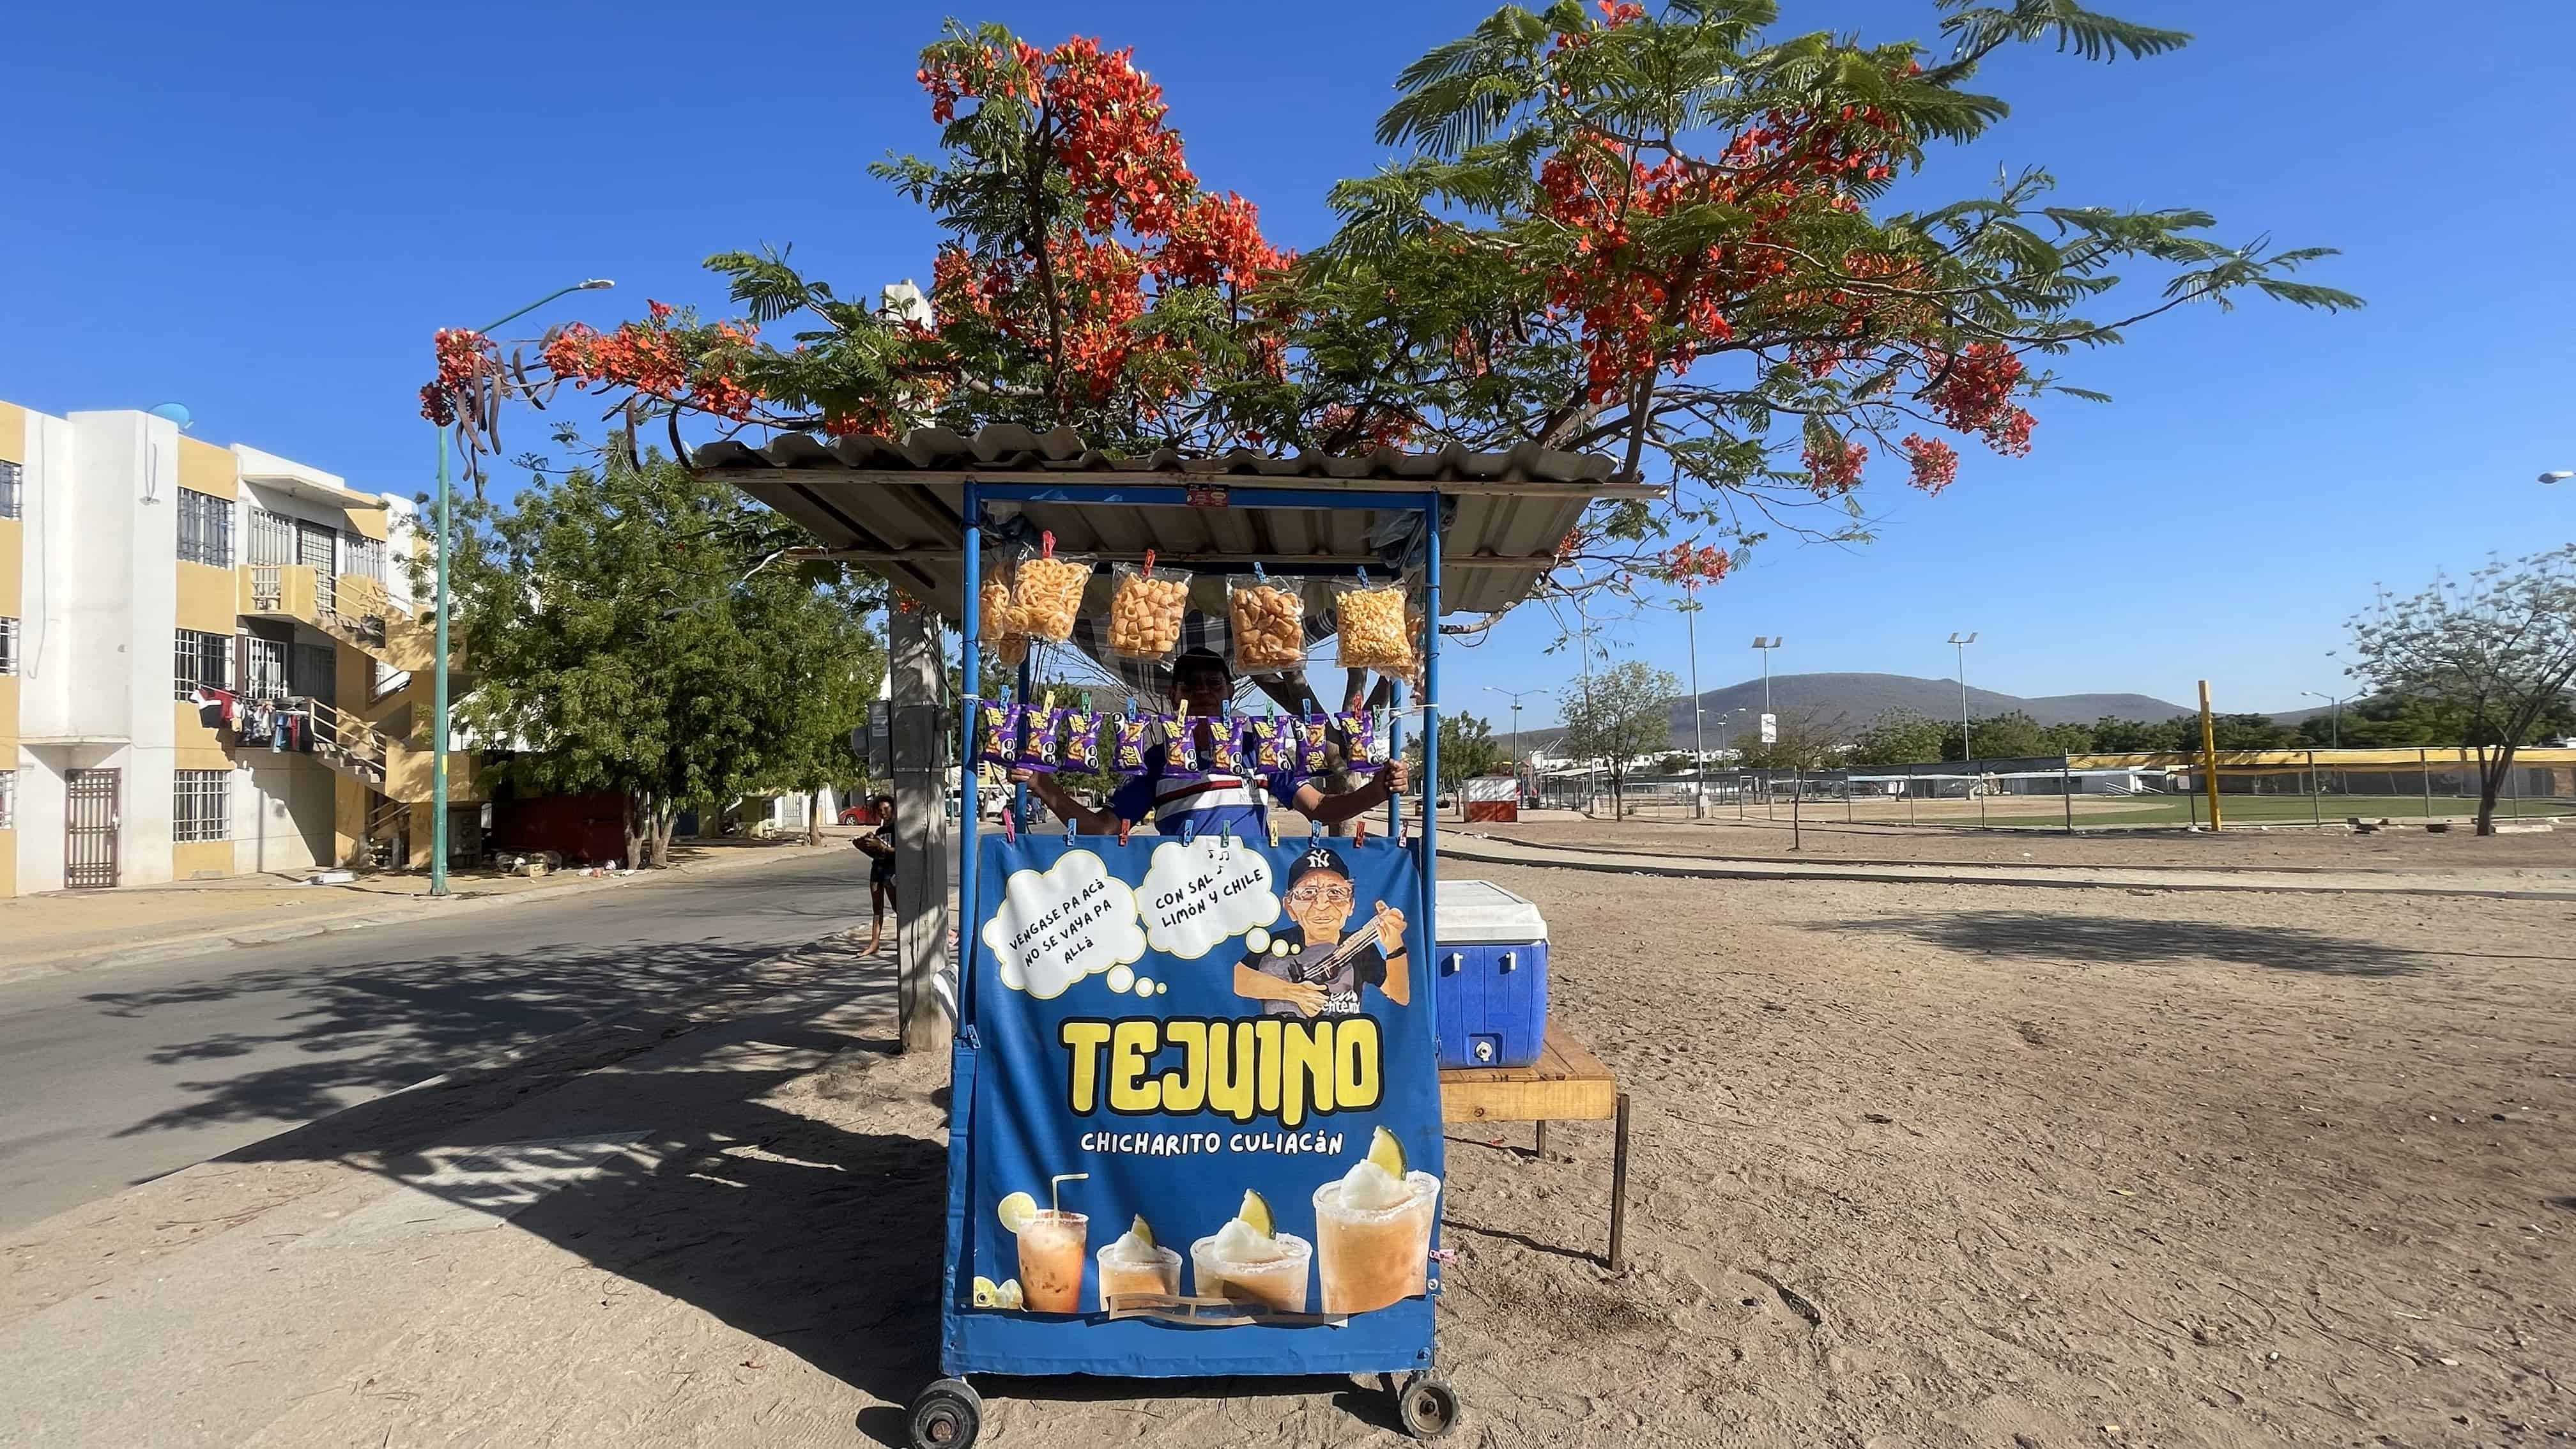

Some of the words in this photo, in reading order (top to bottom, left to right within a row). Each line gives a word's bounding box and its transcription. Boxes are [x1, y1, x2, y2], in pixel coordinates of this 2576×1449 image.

[1155, 888, 1184, 909] CON
[1188, 874, 1213, 894] SAL
[1223, 869, 1264, 896] CHILE
[1009, 908, 1061, 950] VENGASE
[1062, 896, 1080, 914] PA
[1025, 948, 1039, 967] NO
[1043, 935, 1058, 951] SE
[1059, 912, 1093, 939] VAYA
[1094, 899, 1112, 917] PA
[1061, 1017, 1381, 1128] TEJUINO
[1080, 1131, 1222, 1157] CHICHARITO
